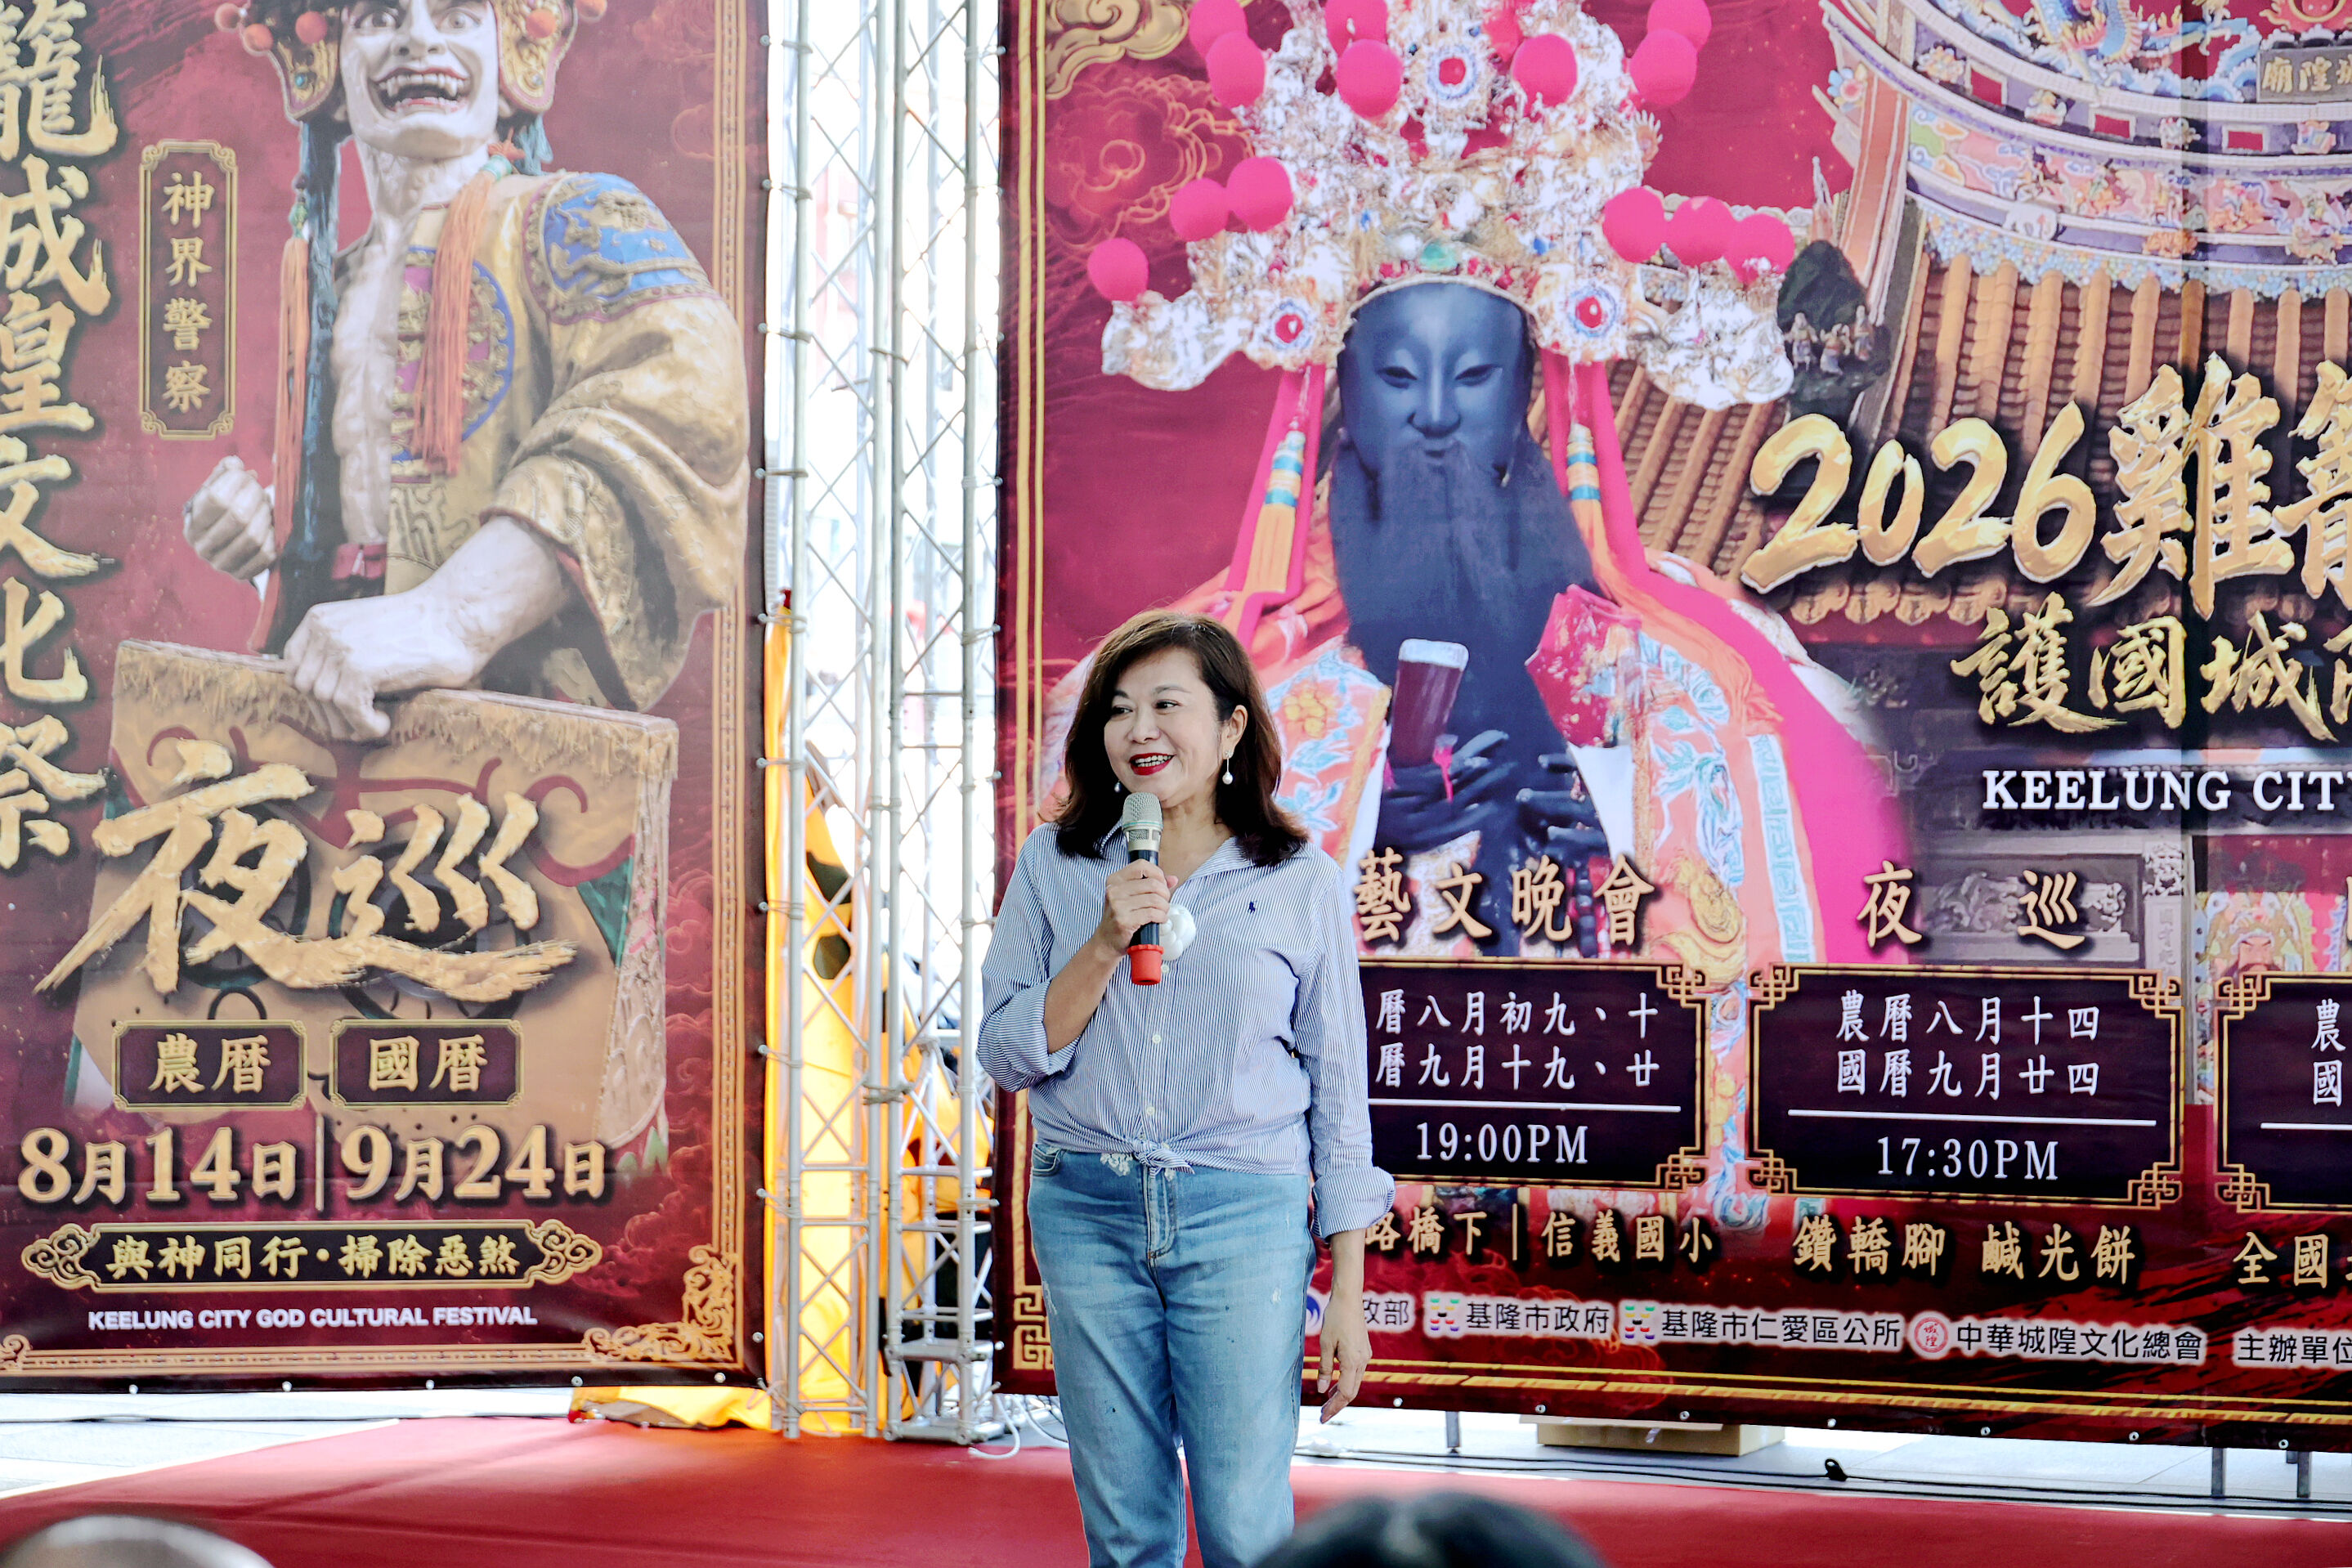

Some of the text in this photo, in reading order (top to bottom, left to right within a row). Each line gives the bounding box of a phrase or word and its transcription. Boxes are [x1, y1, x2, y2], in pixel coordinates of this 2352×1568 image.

[161, 170, 214, 412] 神界警察
[1950, 591, 2352, 742] 護國城
[1982, 769, 2352, 812] KEELUNG CIT
[33, 737, 577, 1001] 夜巡
[1355, 846, 1655, 946] 藝文晚會
[1857, 861, 2085, 950] 夜巡
[1836, 989, 2100, 1046] 農曆八月十四
[1836, 1048, 2100, 1100] 國曆九月廿四
[1416, 1122, 1588, 1164] 19:00PM
[1876, 1136, 2059, 1180] 17:30PM
[1543, 1214, 1714, 1264] 信義國小
[2233, 1231, 2352, 1288] 全國
[87, 1306, 538, 1330] KEELUNG CITY GOD CULTURAL FESTIVAL
[1467, 1301, 1611, 1334] 基隆市政府
[1661, 1310, 1901, 1347] 基隆市仁愛區公所
[1957, 1323, 2202, 1362] 中華城隍文化總會
